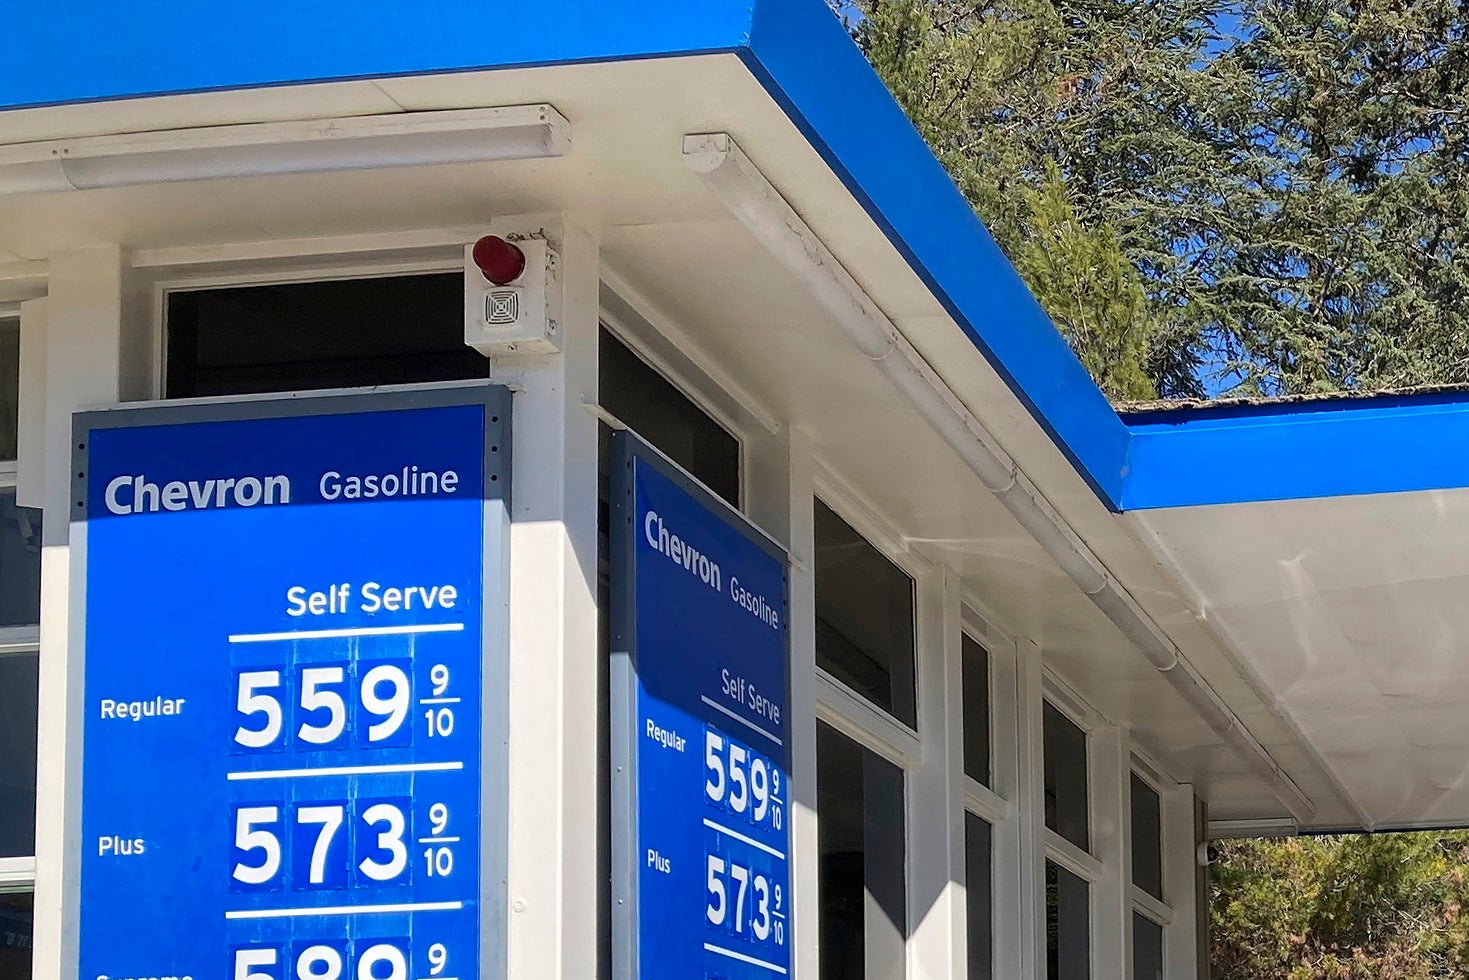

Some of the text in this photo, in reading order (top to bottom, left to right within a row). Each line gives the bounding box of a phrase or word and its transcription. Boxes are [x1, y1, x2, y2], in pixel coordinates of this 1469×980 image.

[105, 465, 459, 515] Chevron Gasoline
[286, 582, 458, 618] Self Serve
[644, 510, 779, 631] Chevron Gasoline
[101, 695, 187, 722] Regular
[234, 665, 410, 749] 559
[721, 668, 781, 726] Self Serve
[646, 719, 687, 752] Regular
[705, 731, 769, 822] 559
[98, 835, 145, 857] Plus
[232, 803, 408, 884] 573
[647, 848, 671, 875] Plus
[706, 854, 770, 942] 573
